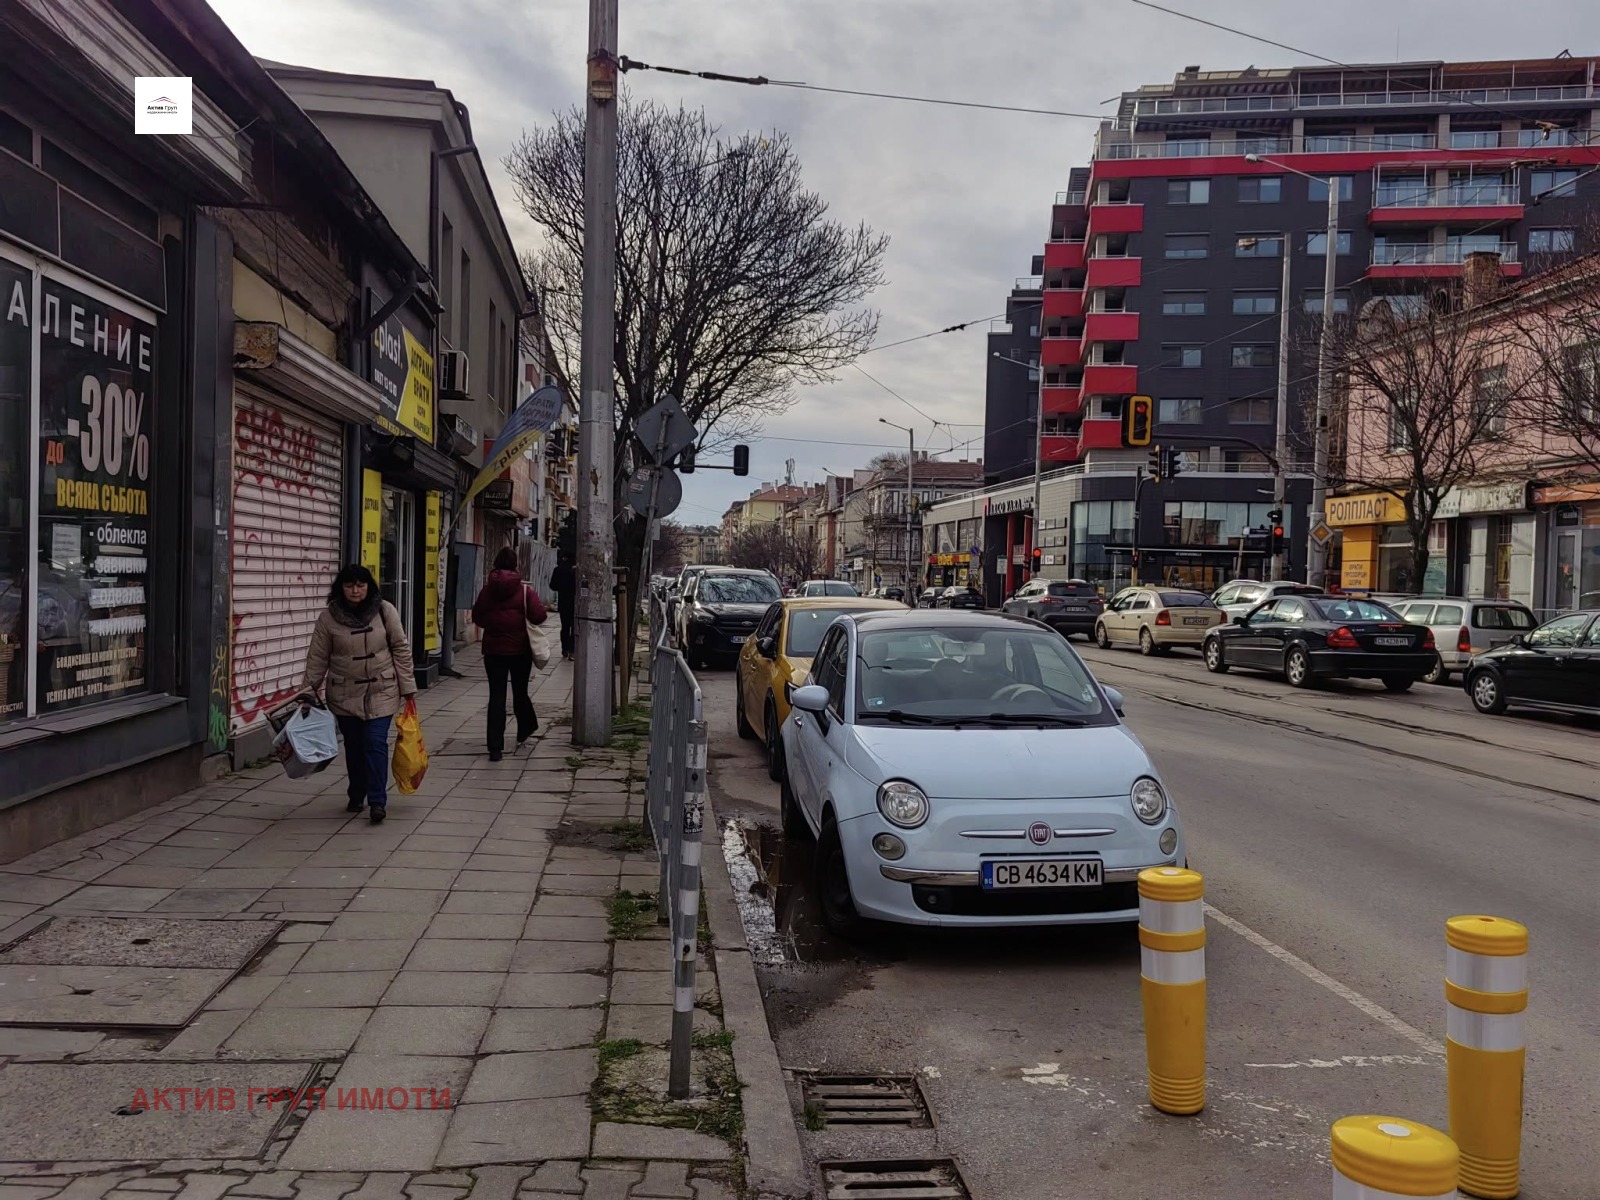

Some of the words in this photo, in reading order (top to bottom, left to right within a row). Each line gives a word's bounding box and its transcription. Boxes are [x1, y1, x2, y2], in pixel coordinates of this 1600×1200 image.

[413, 377, 430, 405] ВРАТИ
[67, 375, 149, 481] -30%
[57, 479, 99, 508] ВСЯКА
[102, 482, 147, 515] СЪБОТА
[1330, 497, 1389, 521] РОЛПЛАСТ
[97, 522, 147, 545] облекла
[97, 557, 147, 574] завивки
[100, 589, 143, 607] одеала
[46, 688, 67, 704] УСЛУГА
[1033, 828, 1047, 840] FIAT
[996, 865, 1021, 885] CB
[1025, 863, 1070, 884] 4634
[1074, 863, 1098, 883] KM
